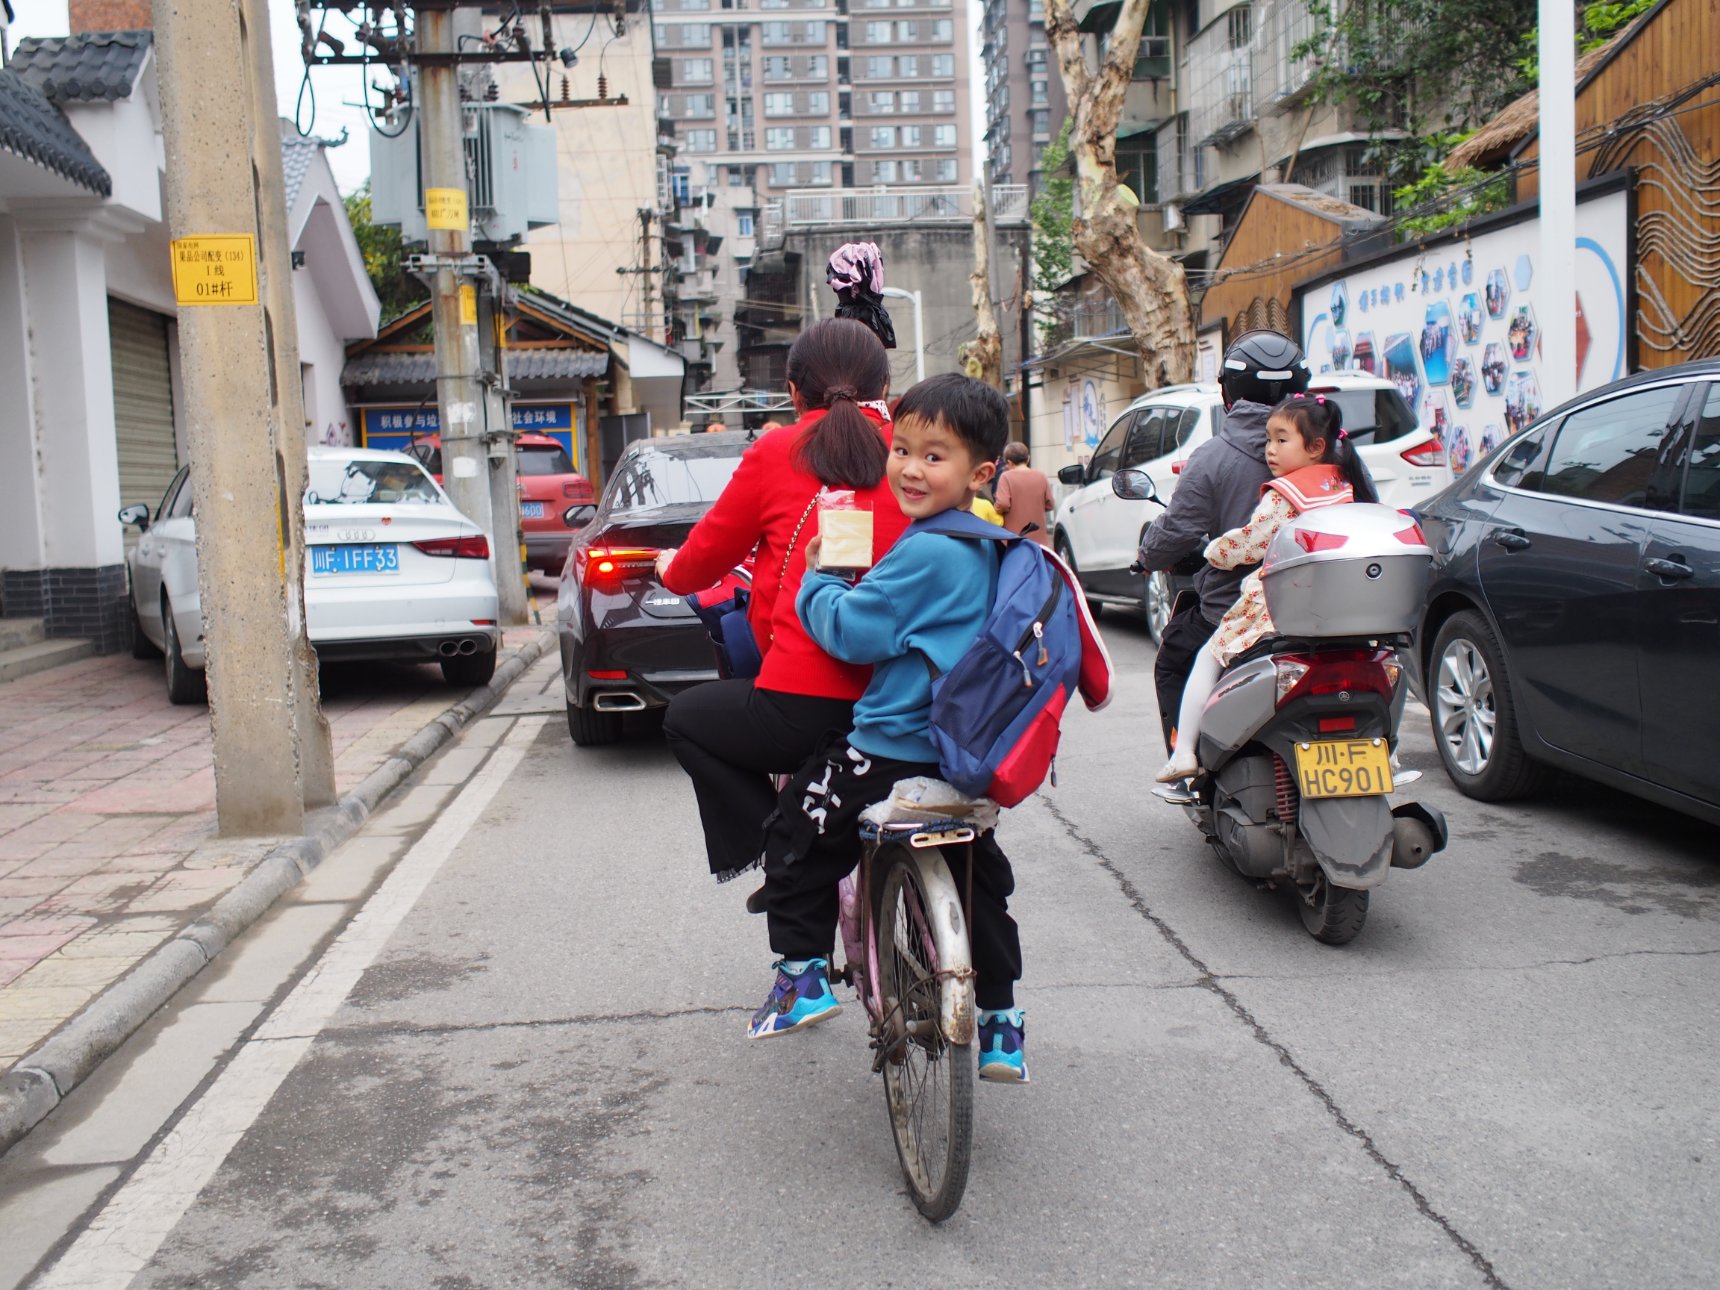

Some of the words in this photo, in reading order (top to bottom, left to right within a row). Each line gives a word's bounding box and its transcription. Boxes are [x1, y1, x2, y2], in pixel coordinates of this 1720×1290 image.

[196, 281, 233, 297] 01#杆
[380, 413, 441, 429] 积极参与垃
[1304, 766, 1385, 795] HC901
